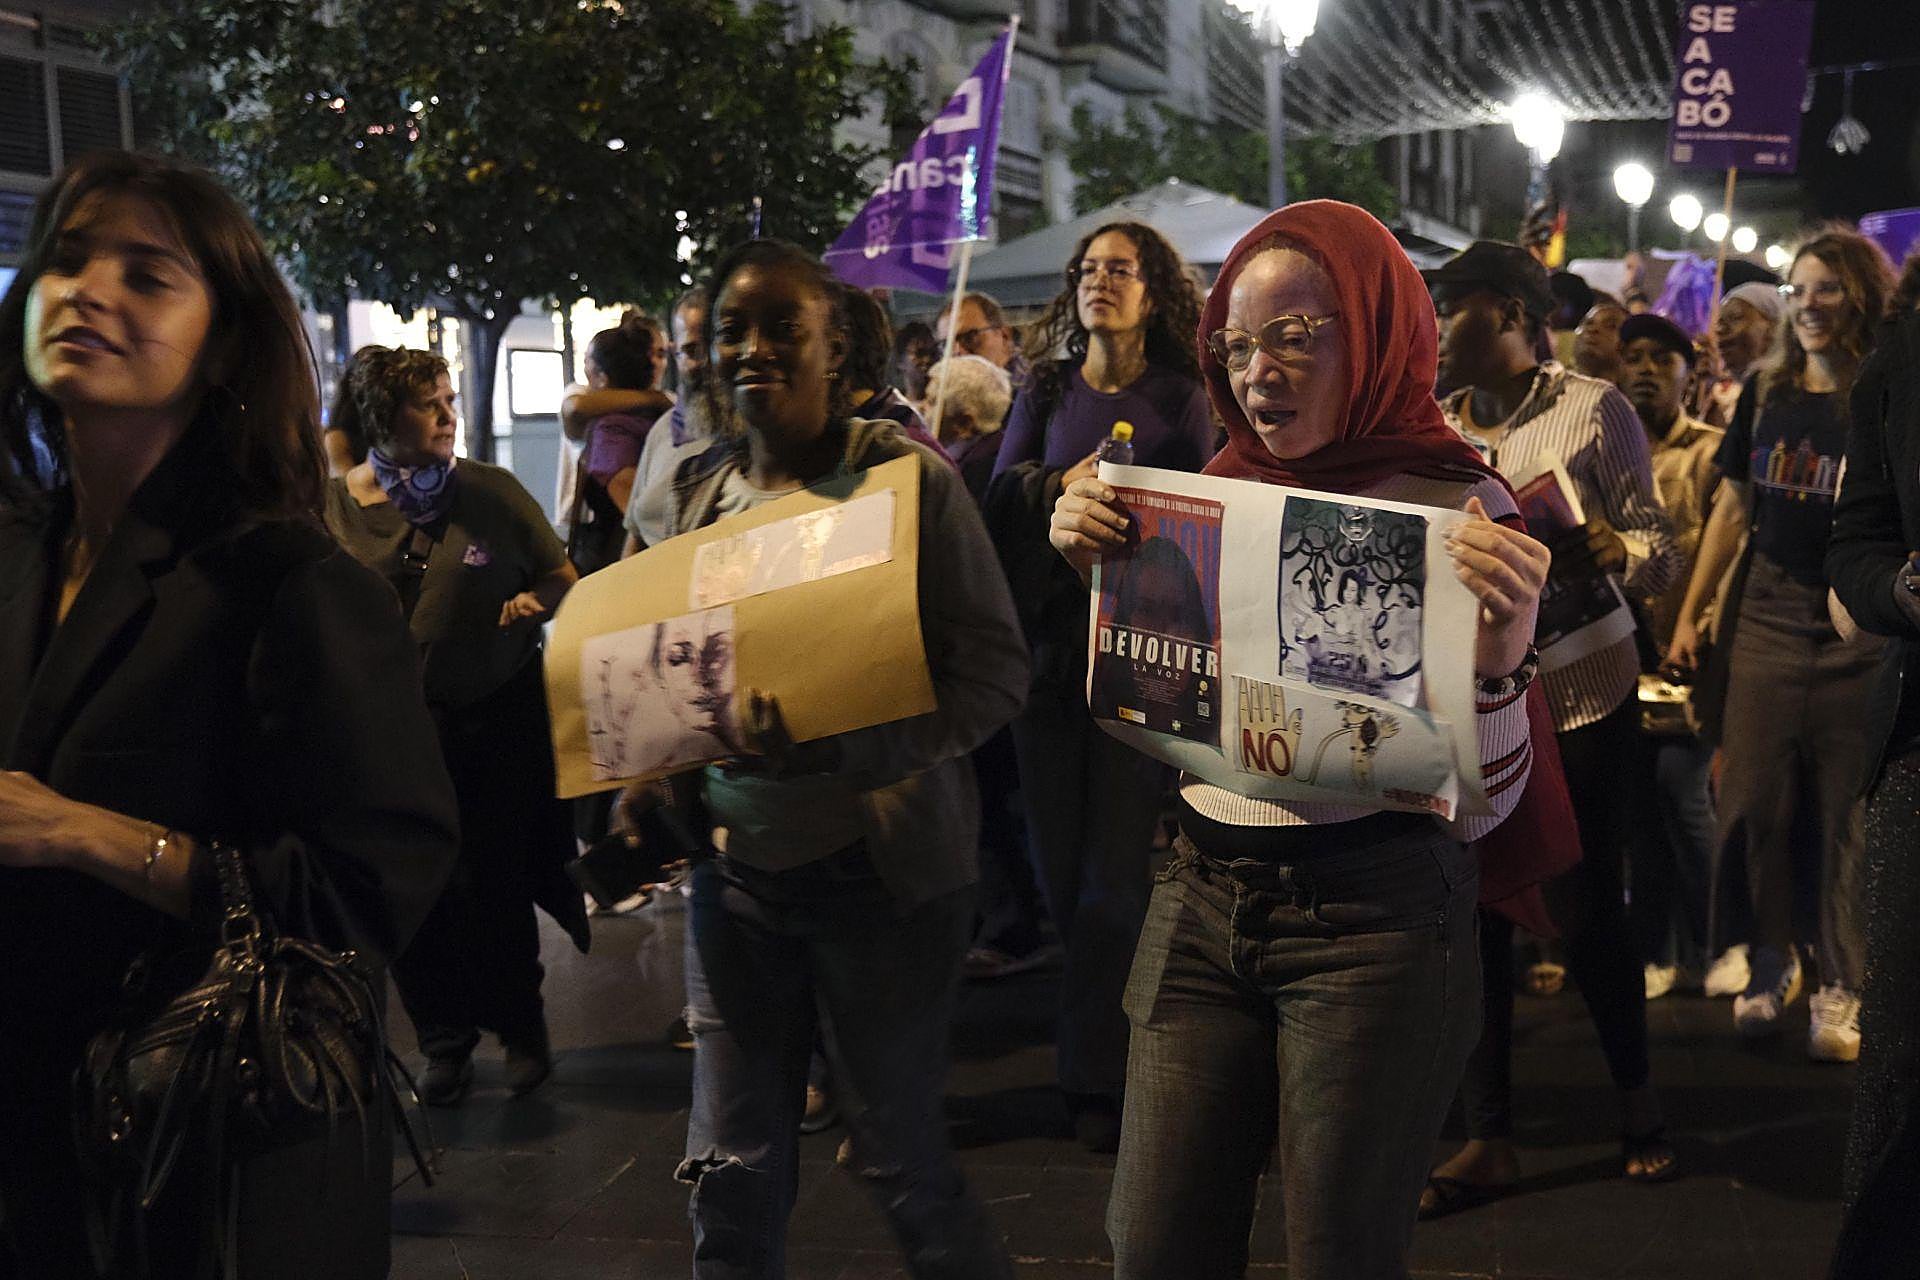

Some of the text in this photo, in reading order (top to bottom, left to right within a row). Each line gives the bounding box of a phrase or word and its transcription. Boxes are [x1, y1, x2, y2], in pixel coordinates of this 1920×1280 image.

[1689, 5, 1738, 33] SE
[1683, 37, 1711, 64] A
[1681, 68, 1734, 96] CA
[1677, 93, 1731, 128] BÓ
[1098, 626, 1218, 678] DEVOLVER
[1133, 663, 1181, 681] LA VOZ
[1243, 727, 1291, 778] NO
